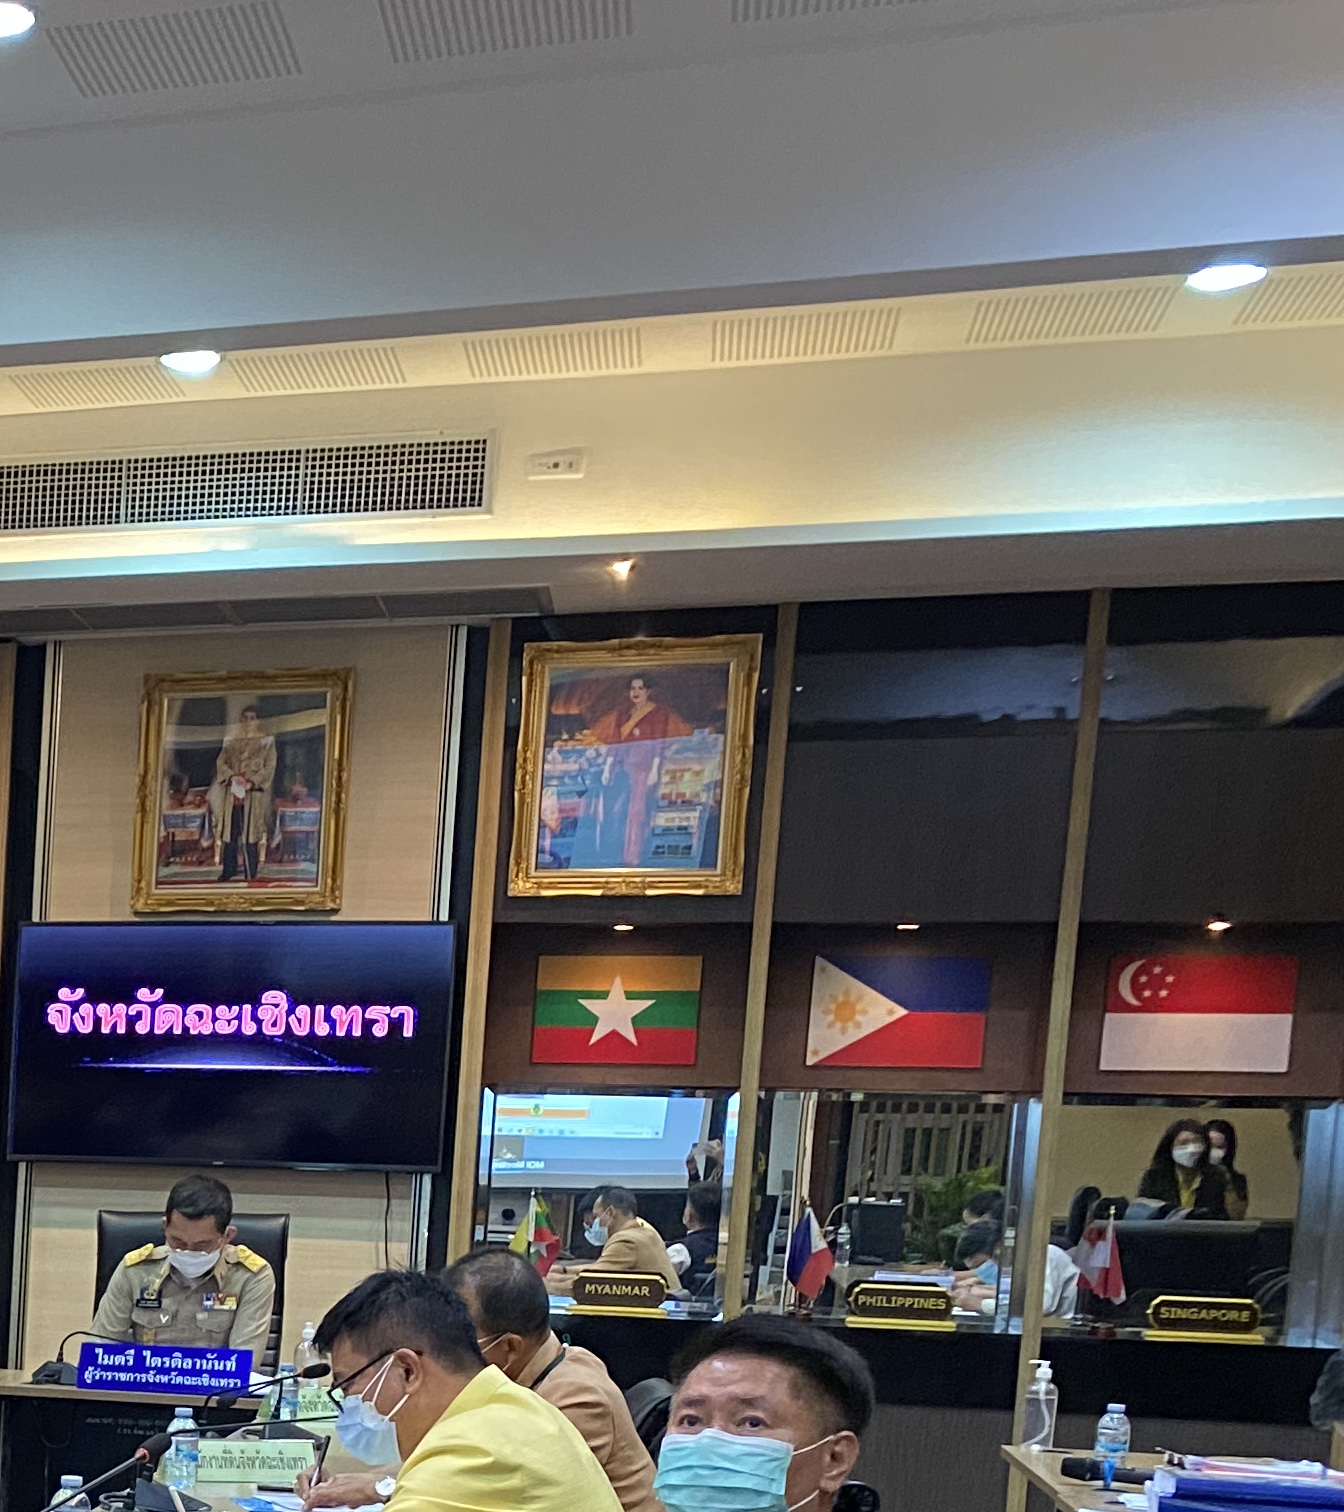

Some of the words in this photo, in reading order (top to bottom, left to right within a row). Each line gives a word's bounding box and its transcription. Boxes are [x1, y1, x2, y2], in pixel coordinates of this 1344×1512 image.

[46, 987, 415, 1038] จังหวัดฉะเชิงเทรา
[585, 1283, 650, 1297] MYANMAR
[858, 1294, 947, 1310] PHILIPPINES
[1159, 1306, 1252, 1322] SINGAPORE
[95, 1347, 135, 1368] ไมตรี
[84, 1366, 242, 1389] ผู้ว่าราชการจังหวัดฉะเชิงเทรา
